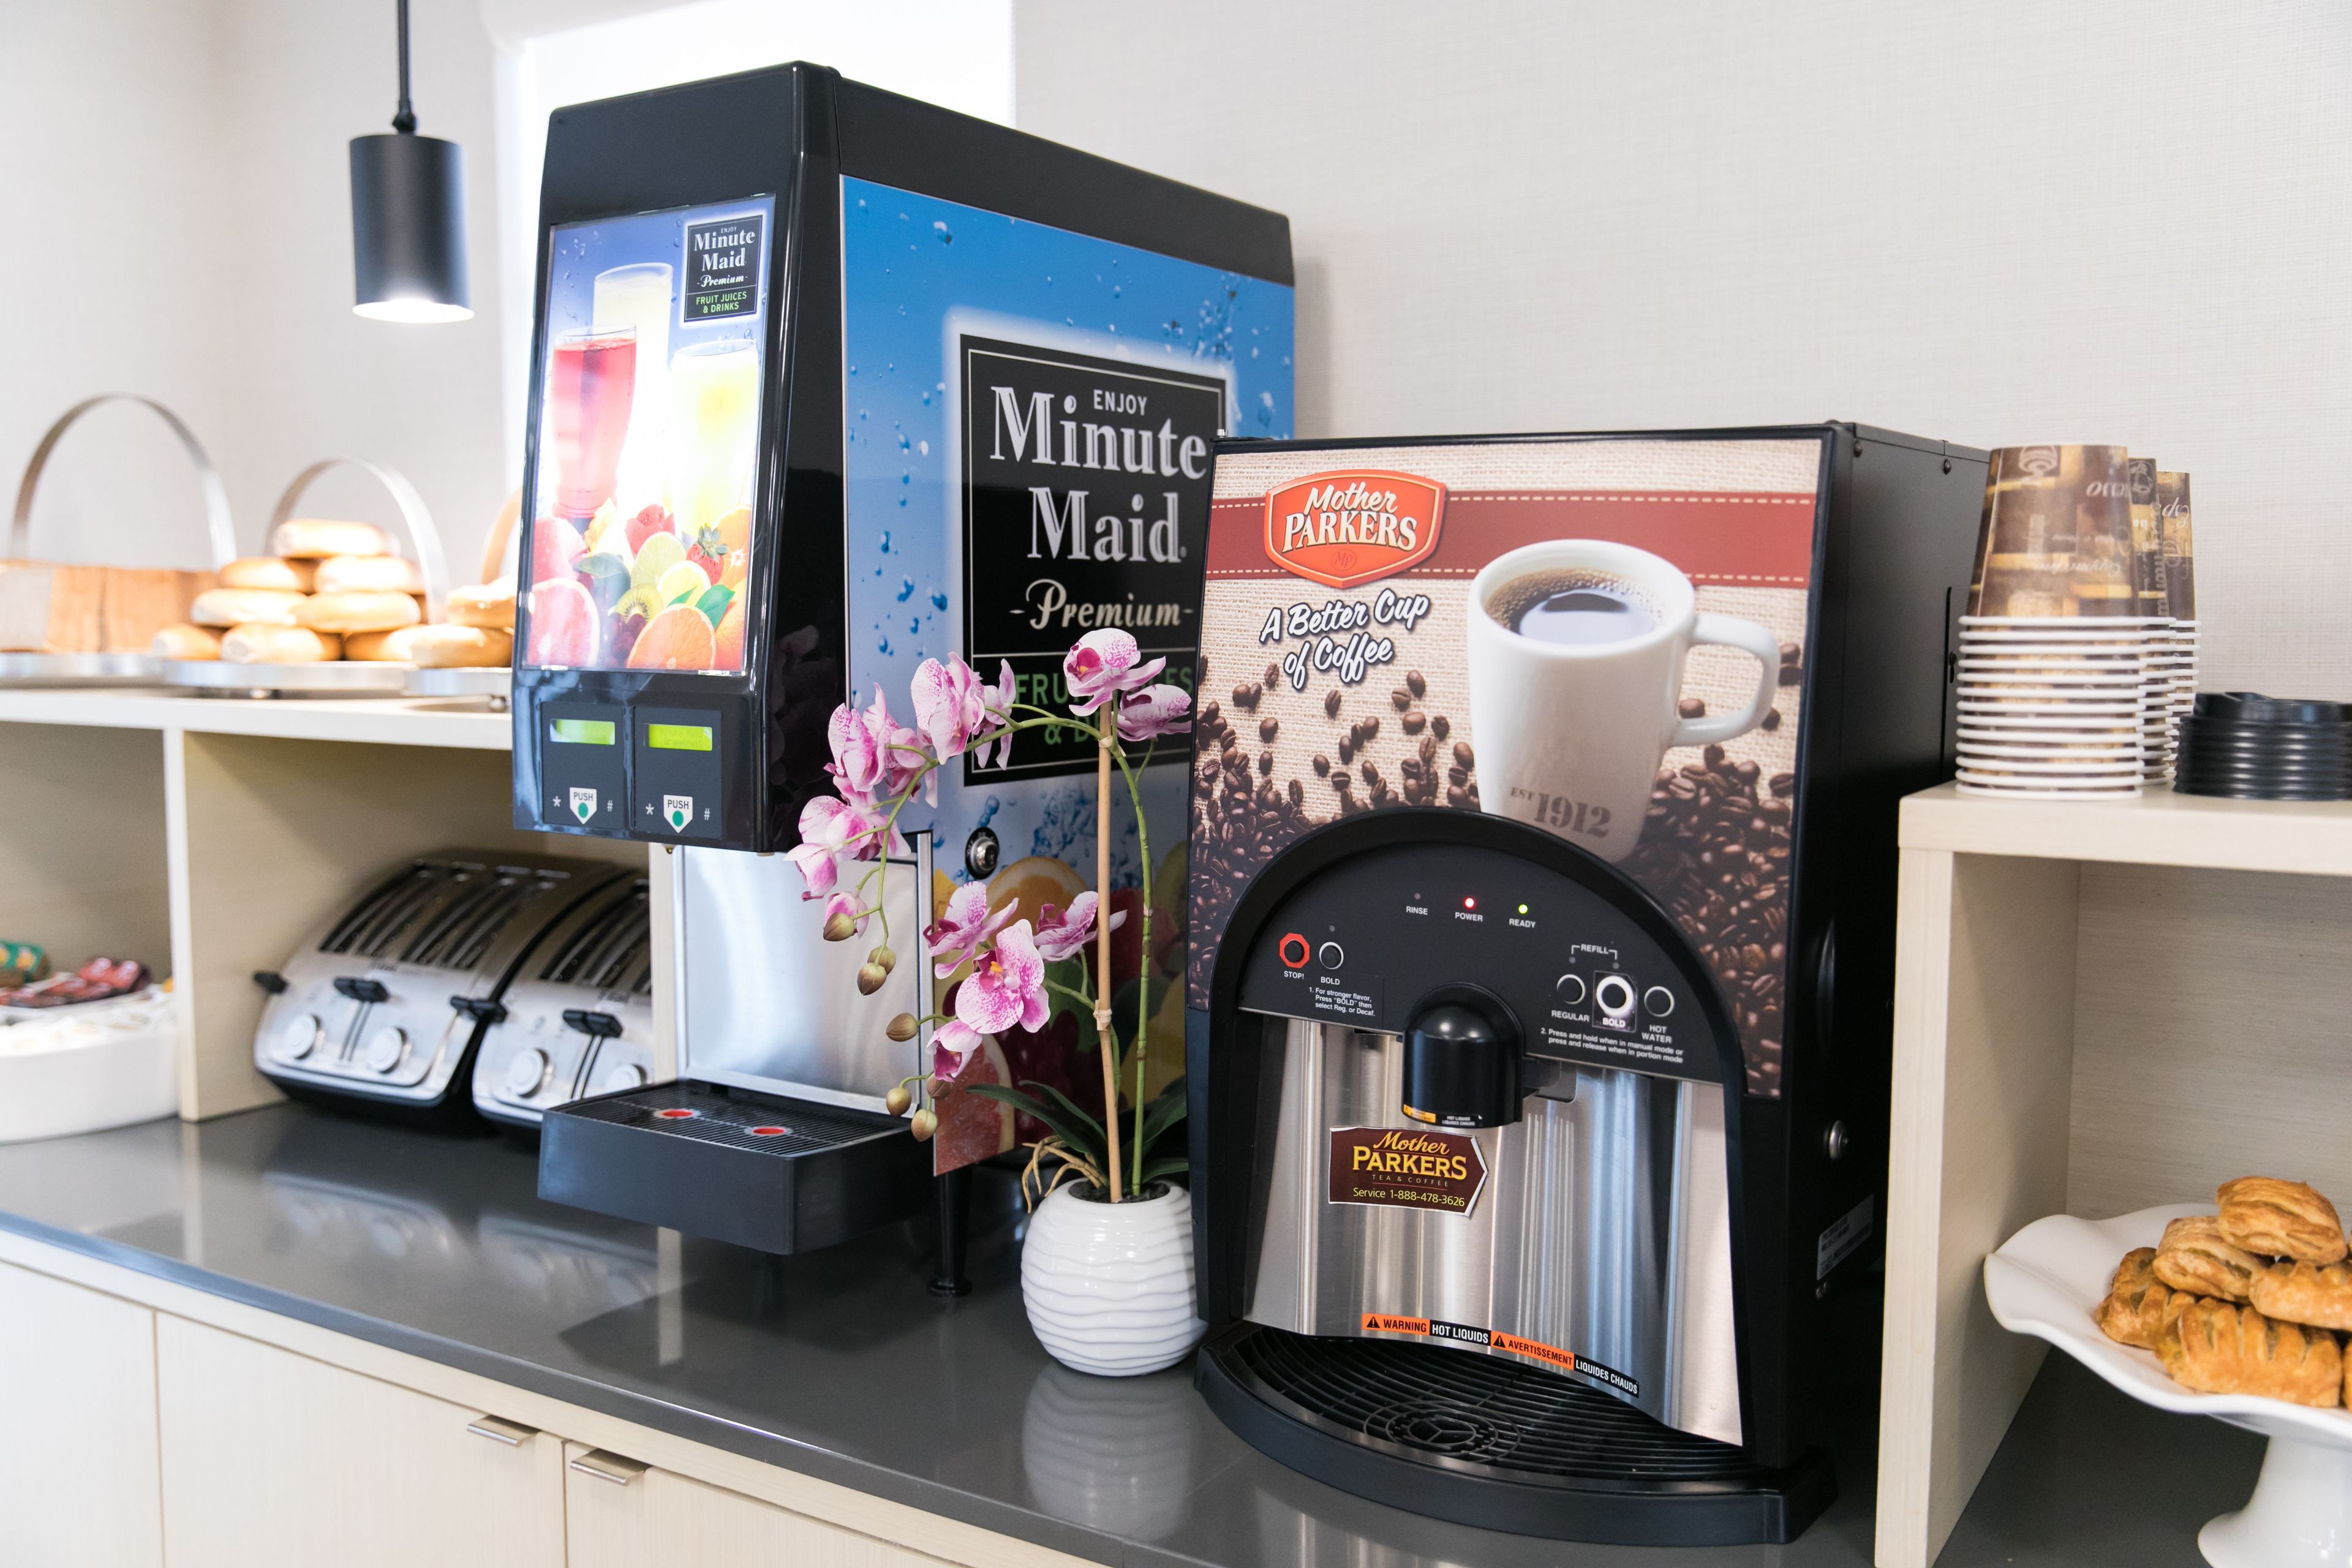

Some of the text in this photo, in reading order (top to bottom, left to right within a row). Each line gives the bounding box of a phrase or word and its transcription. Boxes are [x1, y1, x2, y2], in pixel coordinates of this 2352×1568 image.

[694, 230, 755, 251] Minute
[701, 247, 746, 271] Maid
[696, 292, 747, 305] FRUIT JUICES
[711, 302, 739, 312] DRINKS
[1093, 389, 1147, 416] ENJOY
[990, 386, 1207, 480] Minute
[1304, 481, 1398, 515] Mother
[1027, 487, 1183, 563] Maid
[1282, 511, 1417, 553] PARKERS
[1259, 588, 1430, 643] A Better Cup
[1284, 632, 1393, 690] of Coffee
[573, 792, 593, 802] PUSH
[1510, 787, 1535, 801] EST
[668, 800, 689, 809] PUSH
[1534, 793, 1611, 838] 1912
[1406, 906, 1428, 915] RINSE
[1455, 911, 1483, 922] POWER
[1509, 918, 1536, 928] READY
[1581, 944, 1608, 954] REFILL
[1284, 971, 1304, 979] STOP!
[1321, 976, 1340, 985] BOLD
[1327, 990, 1352, 998] stronger
[1353, 993, 1371, 1002] flavor,
[1334, 1005, 1348, 1013] Reg.
[1551, 1010, 1589, 1022] REGULAR
[1602, 1018, 1626, 1027] BOLD
[1649, 1025, 1667, 1033] HOT
[1548, 1028, 1567, 1038] Press
[1627, 1042, 1653, 1050] manual
[1642, 1032, 1672, 1043] WATER
[1583, 1042, 1607, 1051] release
[1636, 1051, 1662, 1060] portion
[1663, 1055, 1683, 1063] mode
[1373, 1131, 1449, 1155] Mother
[1352, 1146, 1467, 1180] PARKERS
[1408, 1177, 1449, 1187] COFFEE
[1353, 1187, 1465, 1207] Service 1-888-478-3626
[1383, 1319, 1488, 1344] WARNING HOT LIQUIDS
[1508, 1340, 1637, 1395] AVERTISSEMENT LIQUIDES CHAUDS
